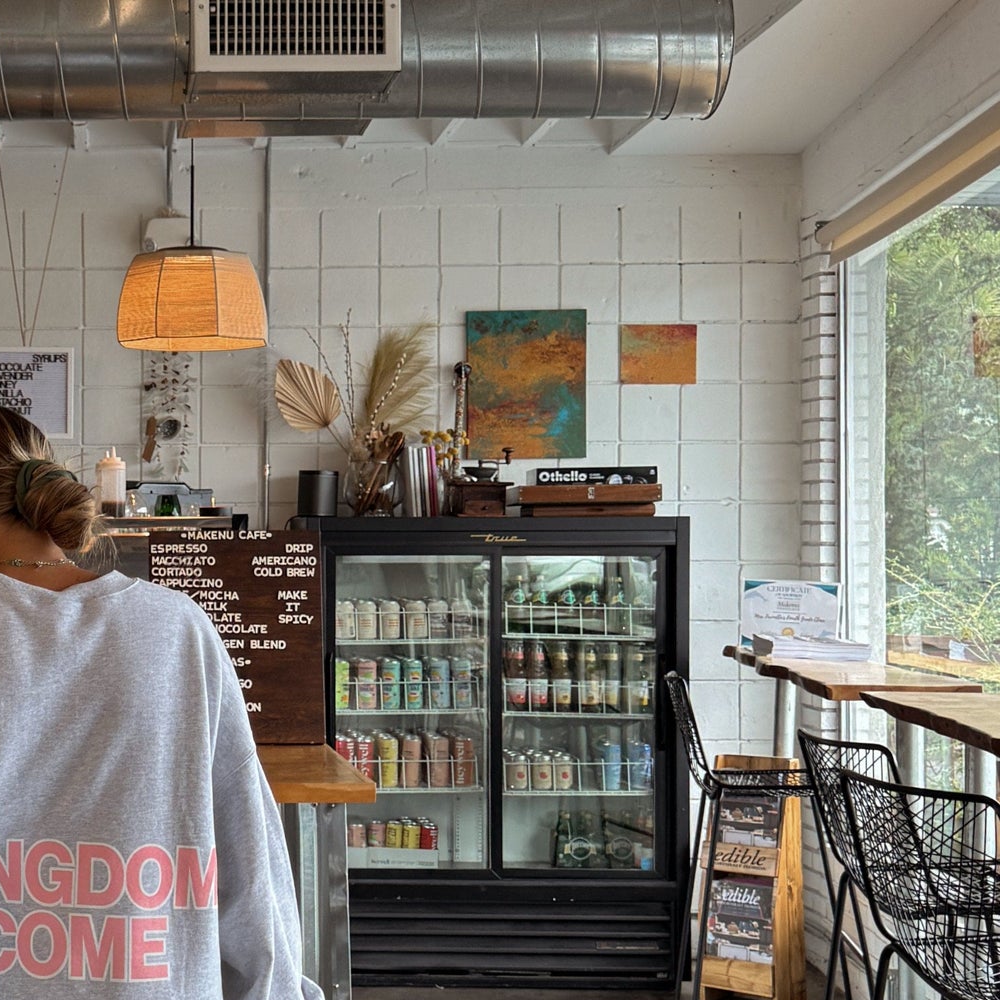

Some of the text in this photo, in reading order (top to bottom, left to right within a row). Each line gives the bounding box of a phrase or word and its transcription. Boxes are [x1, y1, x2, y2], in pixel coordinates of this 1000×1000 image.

[32, 354, 66, 363] SYRUPS
[539, 471, 587, 482] Othello
[188, 531, 267, 540] MAKENU CAFE
[150, 544, 208, 554] ESPRESSO
[286, 544, 313, 553] DRIP
[151, 556, 216, 566] MACCHIATO
[252, 556, 317, 566] AMERICANO
[151, 567, 202, 577] CORTADO
[254, 567, 315, 577] COLD BREW
[278, 591, 308, 600] MAKE
[285, 602, 300, 612] IT
[278, 614, 314, 624] SPICY
[223, 640, 287, 649] GEN BLEND
[246, 702, 261, 712] ON
[714, 847, 766, 866] edible
